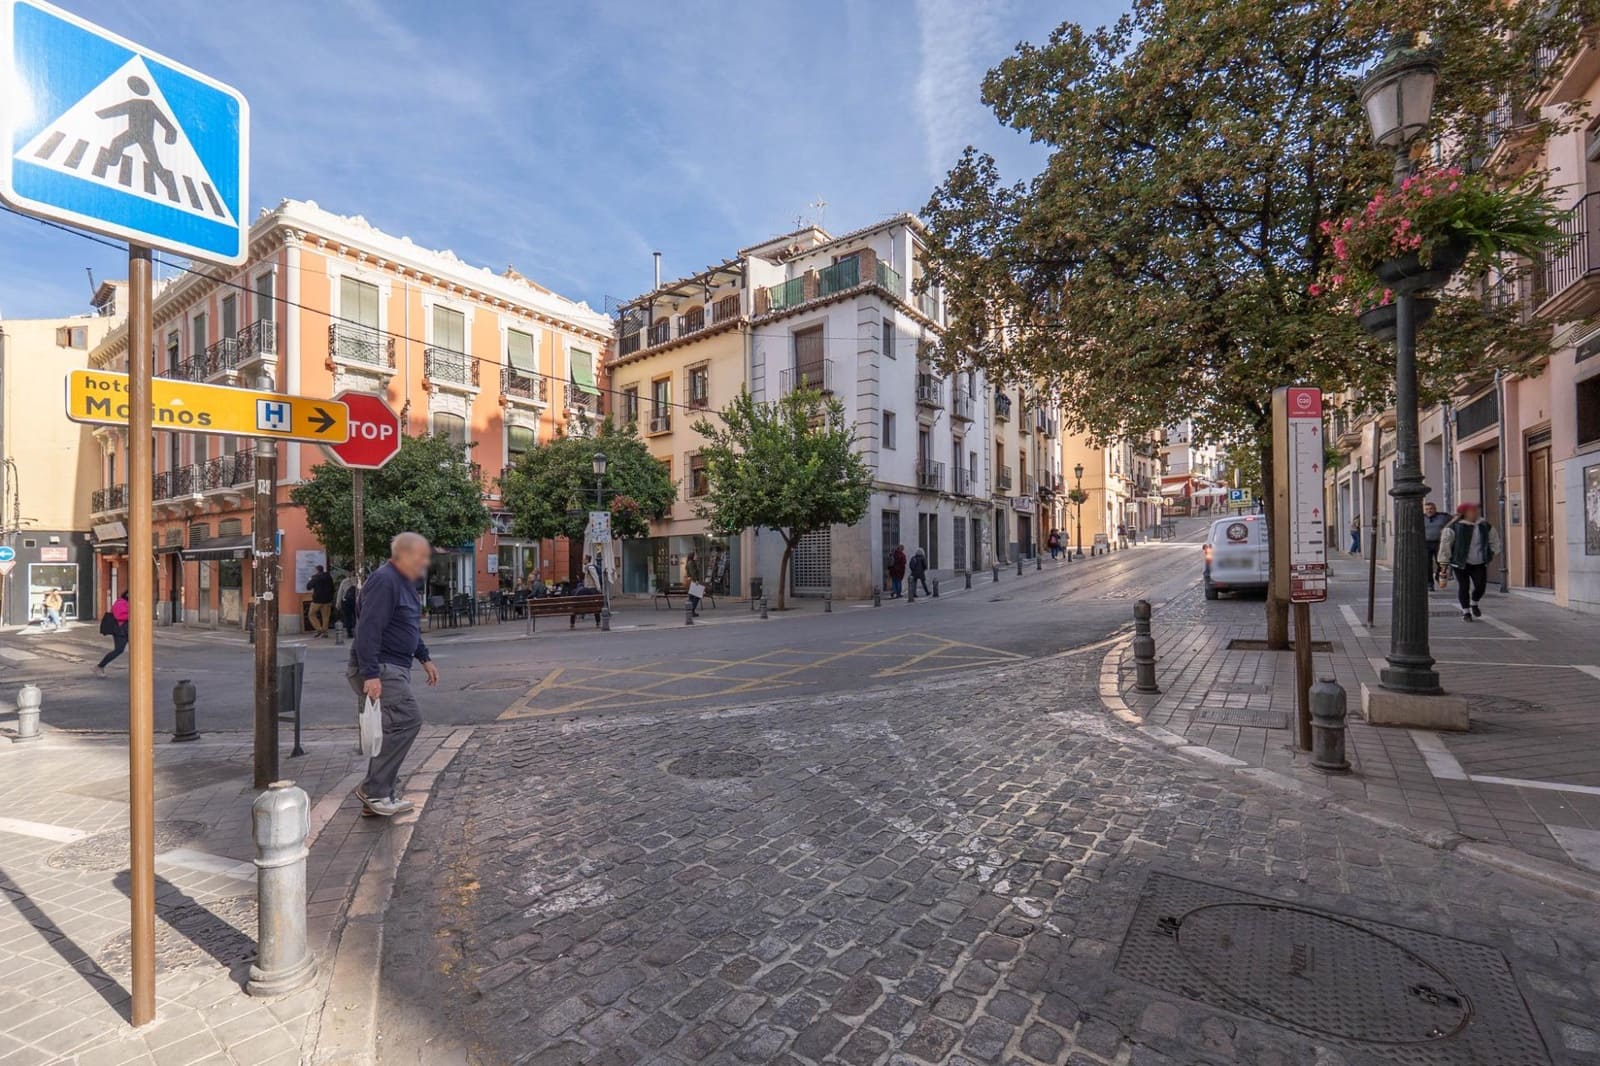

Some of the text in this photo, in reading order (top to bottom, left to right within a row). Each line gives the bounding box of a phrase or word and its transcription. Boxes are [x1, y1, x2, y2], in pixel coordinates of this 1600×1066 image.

[85, 376, 129, 392] hot
[85, 396, 212, 426] Moinos
[265, 403, 284, 423] H
[349, 420, 393, 441] TOP
[1231, 491, 1241, 499] P
